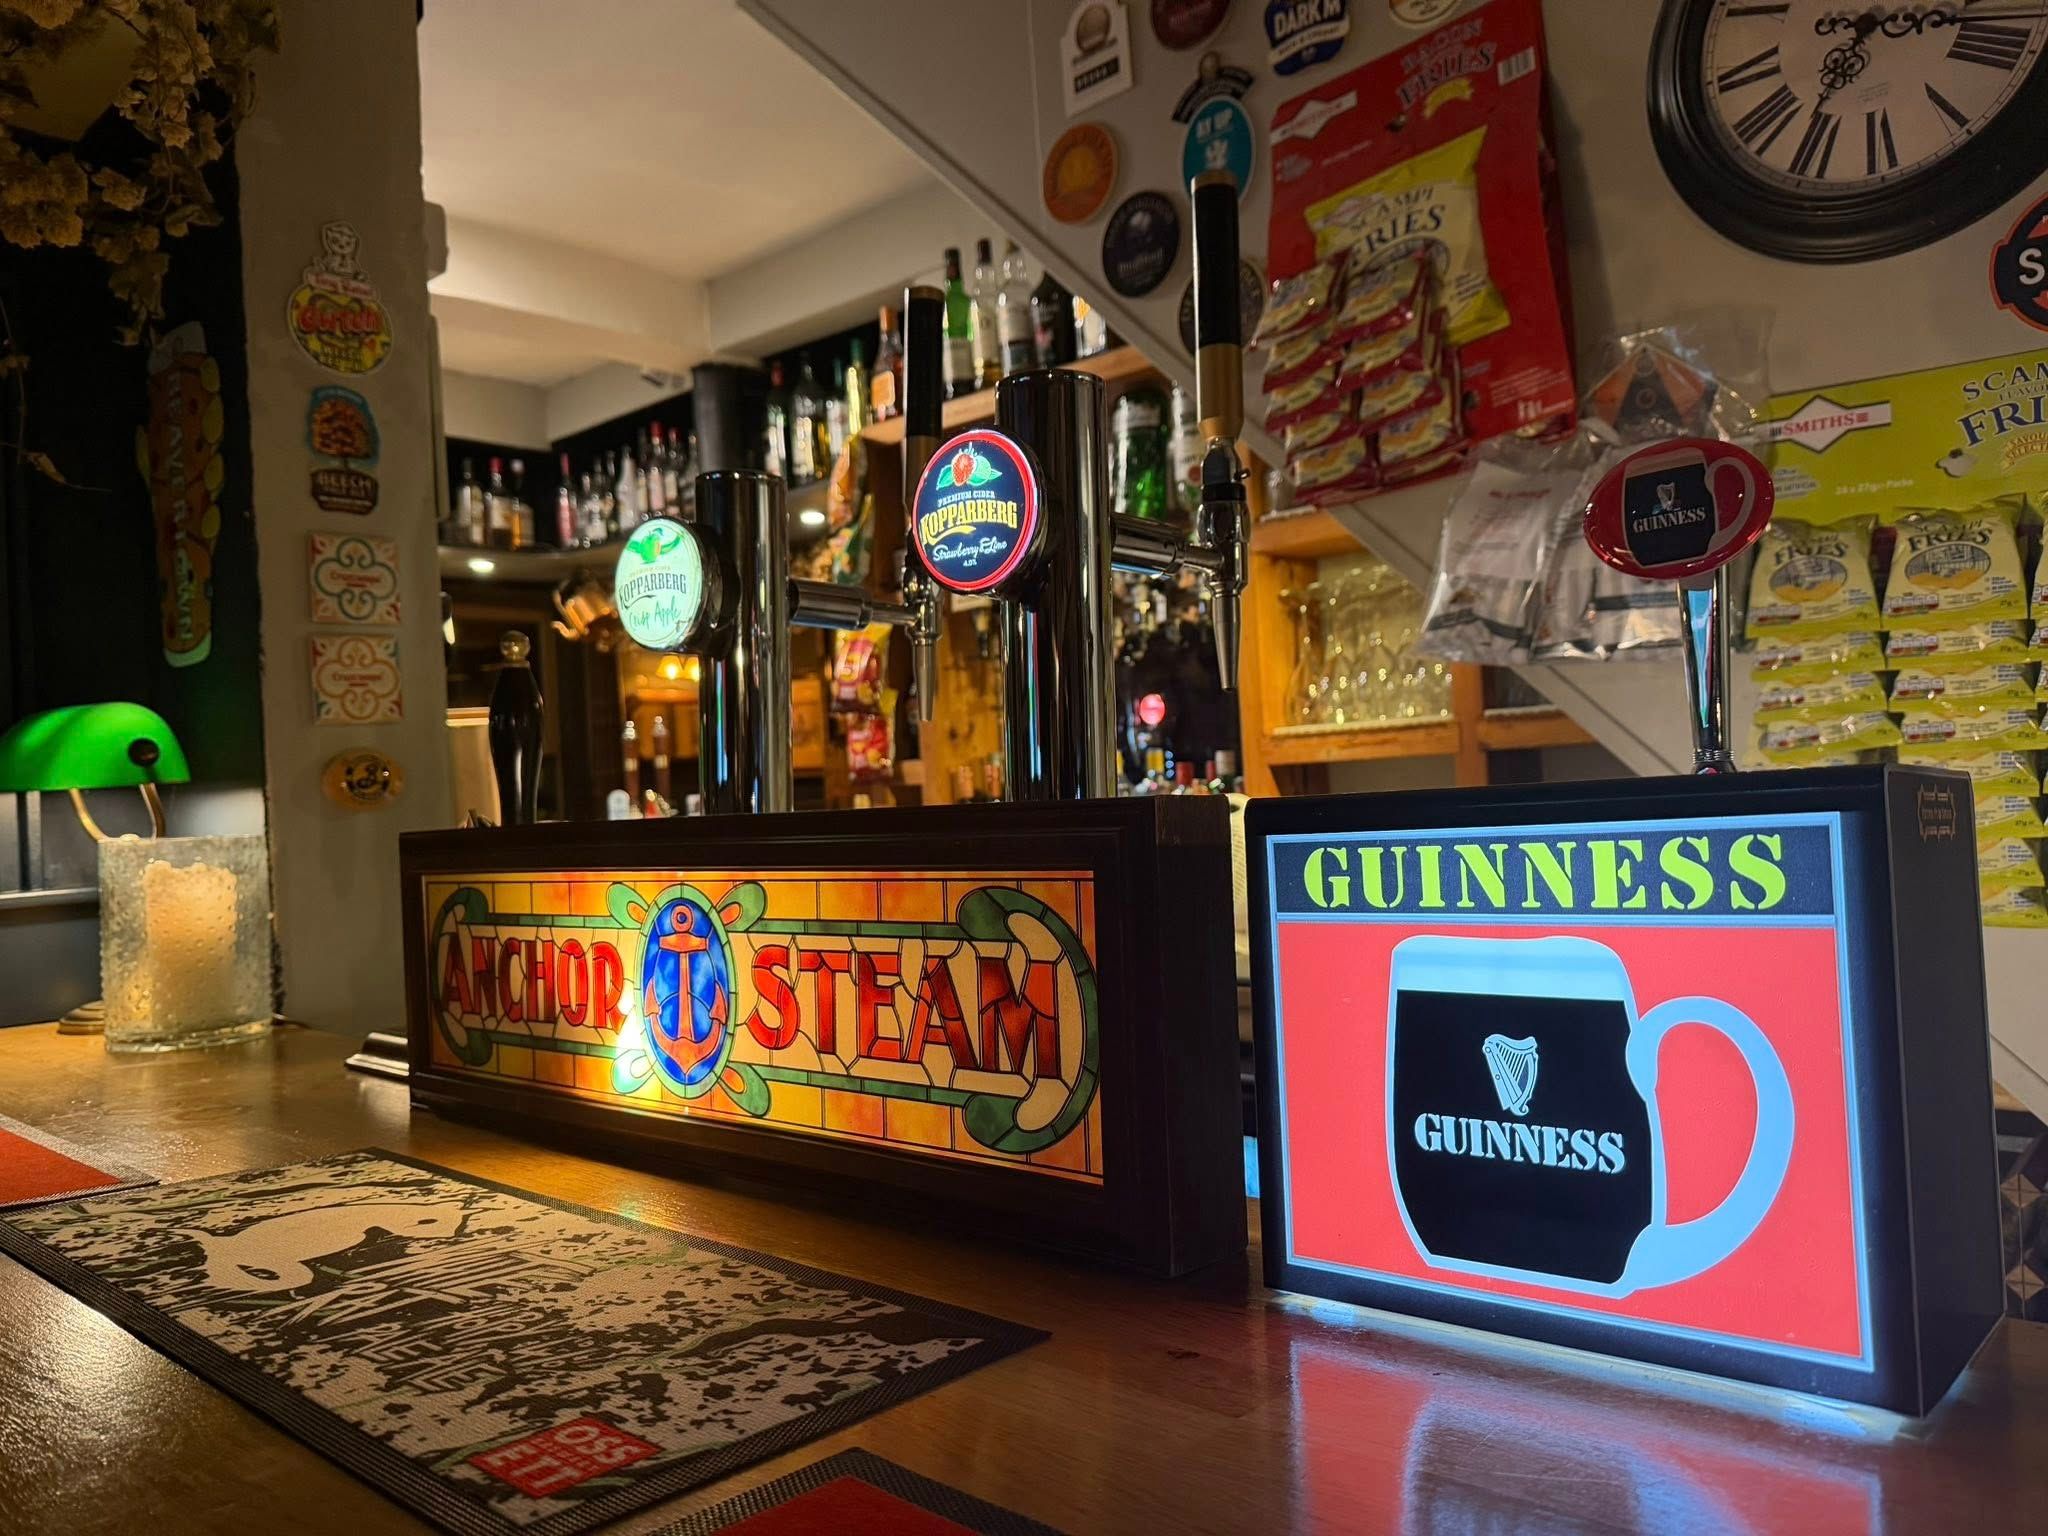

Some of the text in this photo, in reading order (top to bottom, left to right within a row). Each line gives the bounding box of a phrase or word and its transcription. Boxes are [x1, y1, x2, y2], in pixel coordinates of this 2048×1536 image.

[1274, 0, 1322, 40] DARK
[1397, 41, 1498, 110] FRIES
[1351, 205, 1446, 267] FRIES
[2018, 246, 2046, 286] S
[1783, 412, 1855, 436] SMITHS
[937, 489, 996, 507] PREMIUM CIDER
[920, 499, 1018, 545] KOPPARBERG
[1632, 506, 1707, 533] GUINNESS
[1908, 528, 1993, 551] FRIES
[933, 541, 980, 562] Strawberry
[618, 572, 687, 611] KOPPARBERG
[654, 595, 682, 627] Apple
[1303, 834, 1787, 911] GUINNESS
[442, 935, 1060, 1080] ANCHOR STEAM
[1413, 1111, 1626, 1175] GUINNESS
